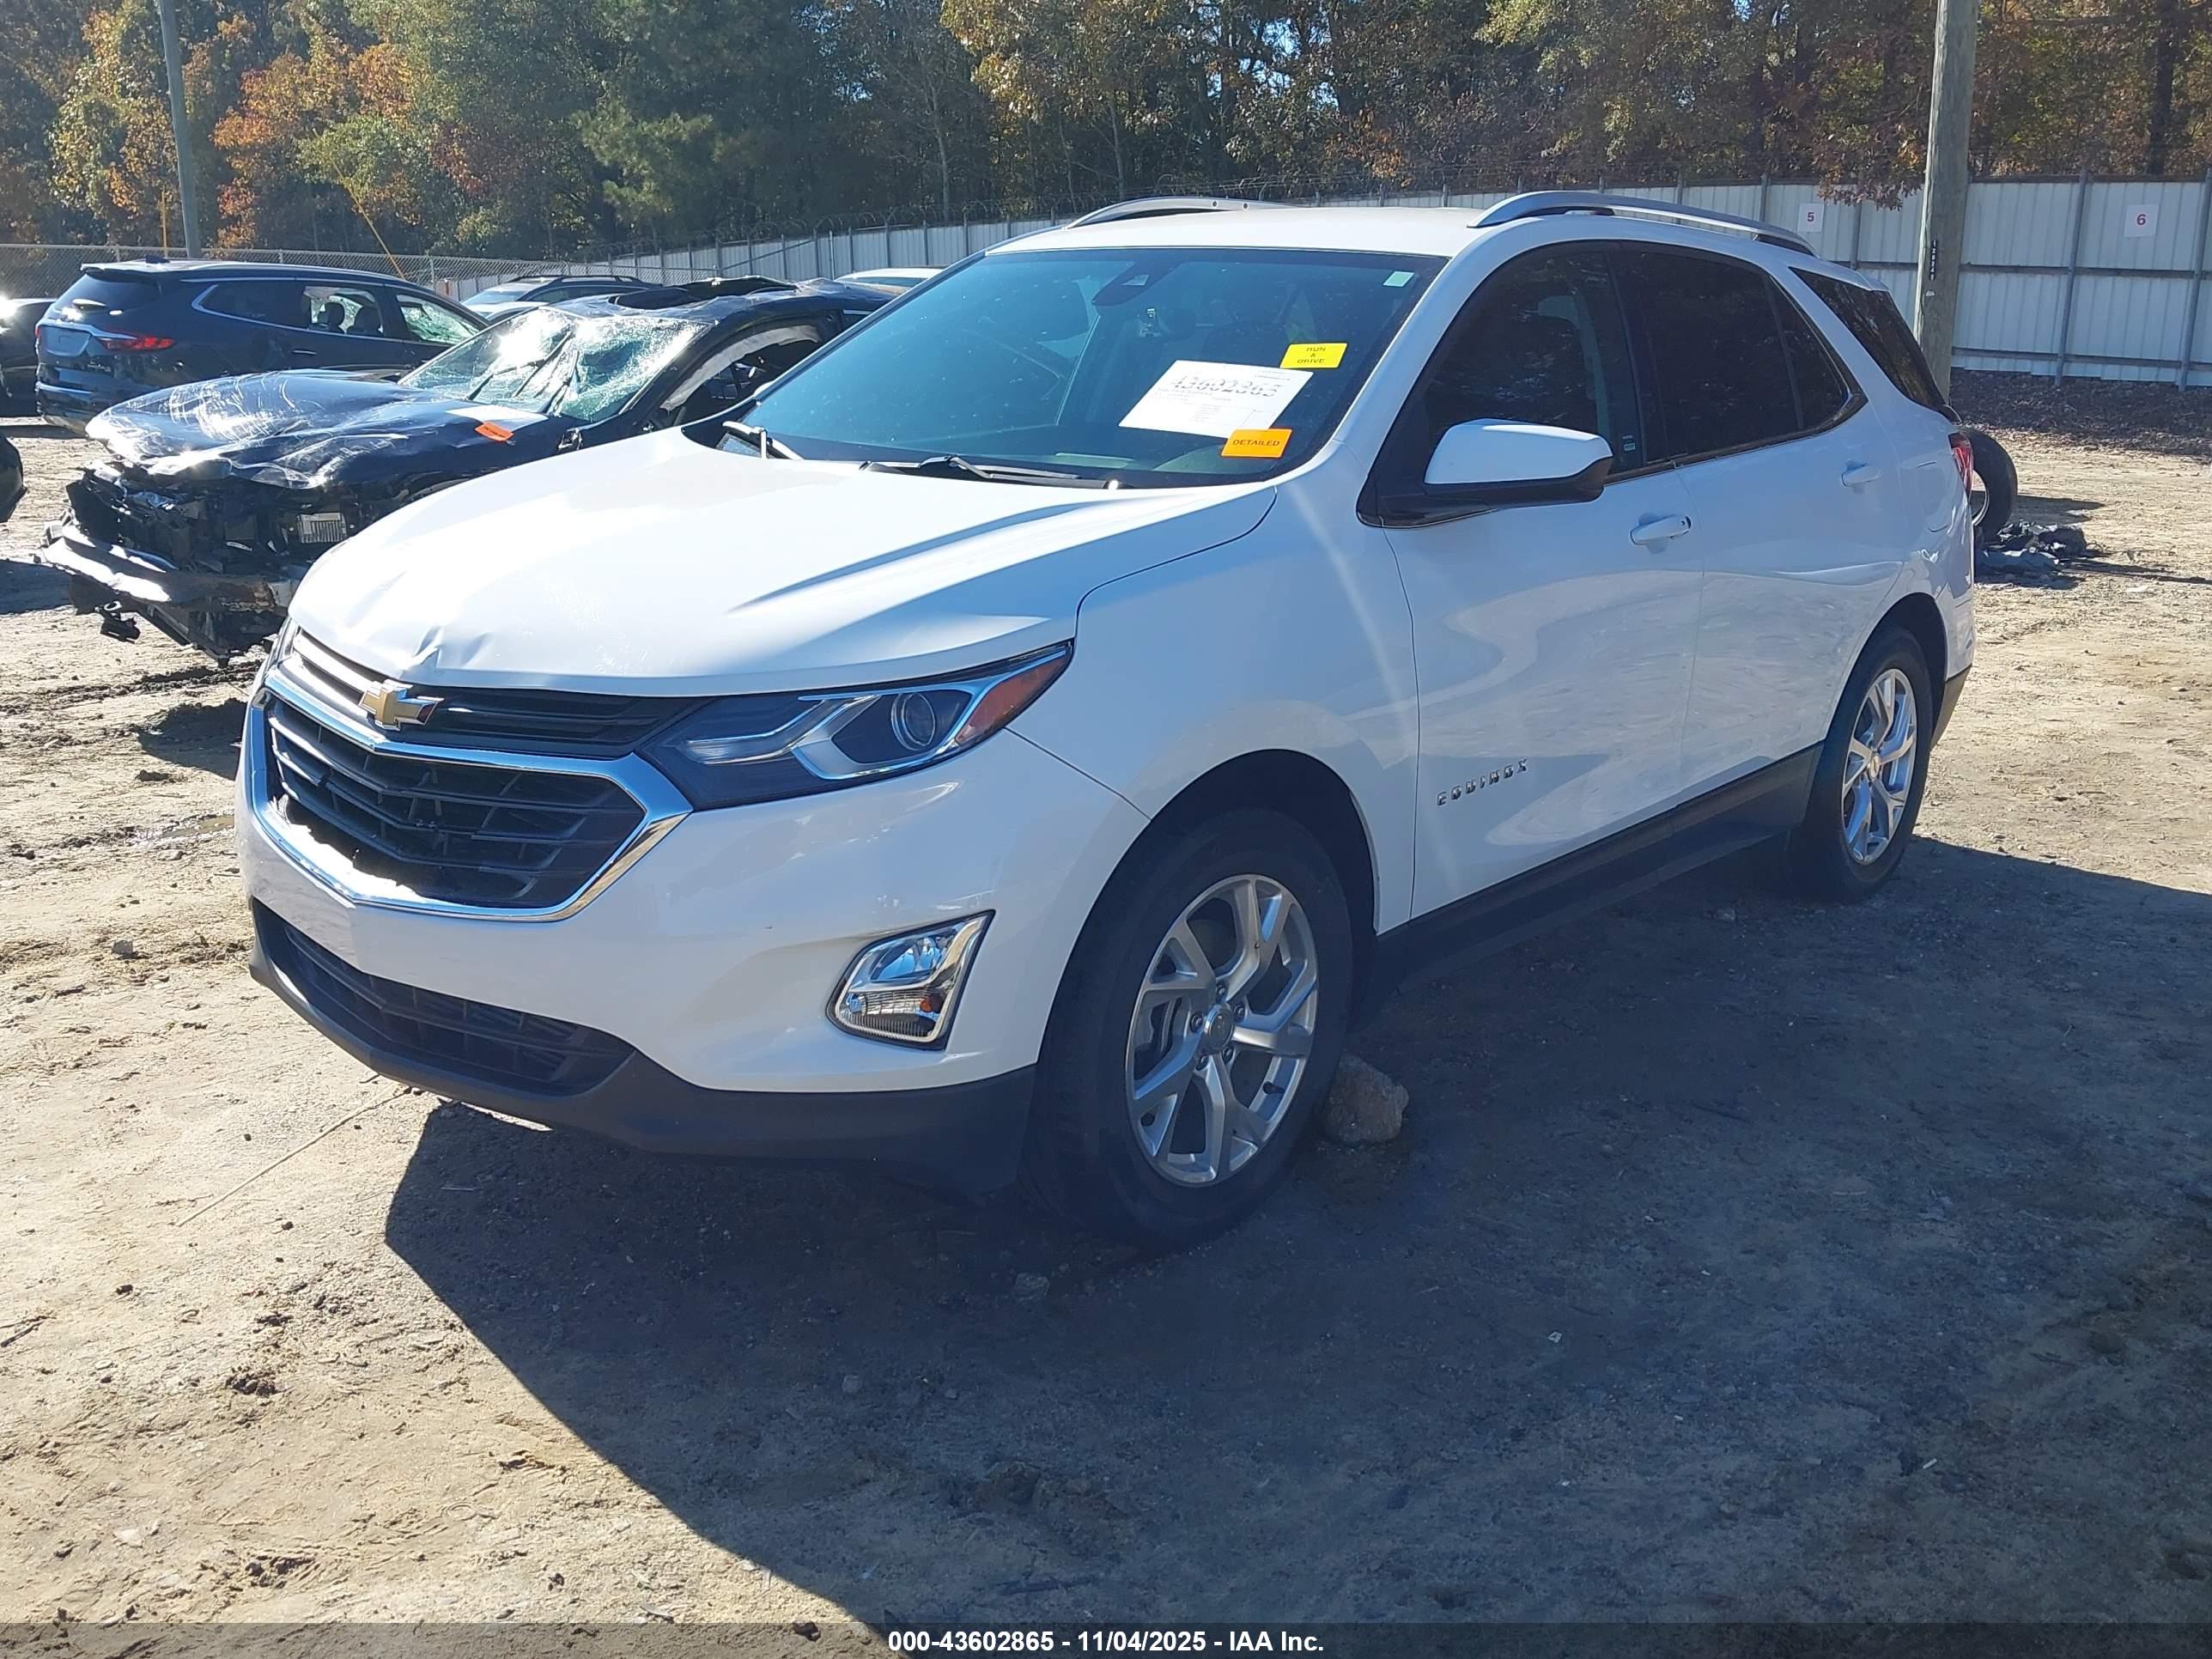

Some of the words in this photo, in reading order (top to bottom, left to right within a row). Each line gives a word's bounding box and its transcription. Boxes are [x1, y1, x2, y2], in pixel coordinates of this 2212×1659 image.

[1807, 211, 1814, 222] 5
[2136, 213, 2147, 226] 6
[1436, 758, 1528, 806] EQUINOX
